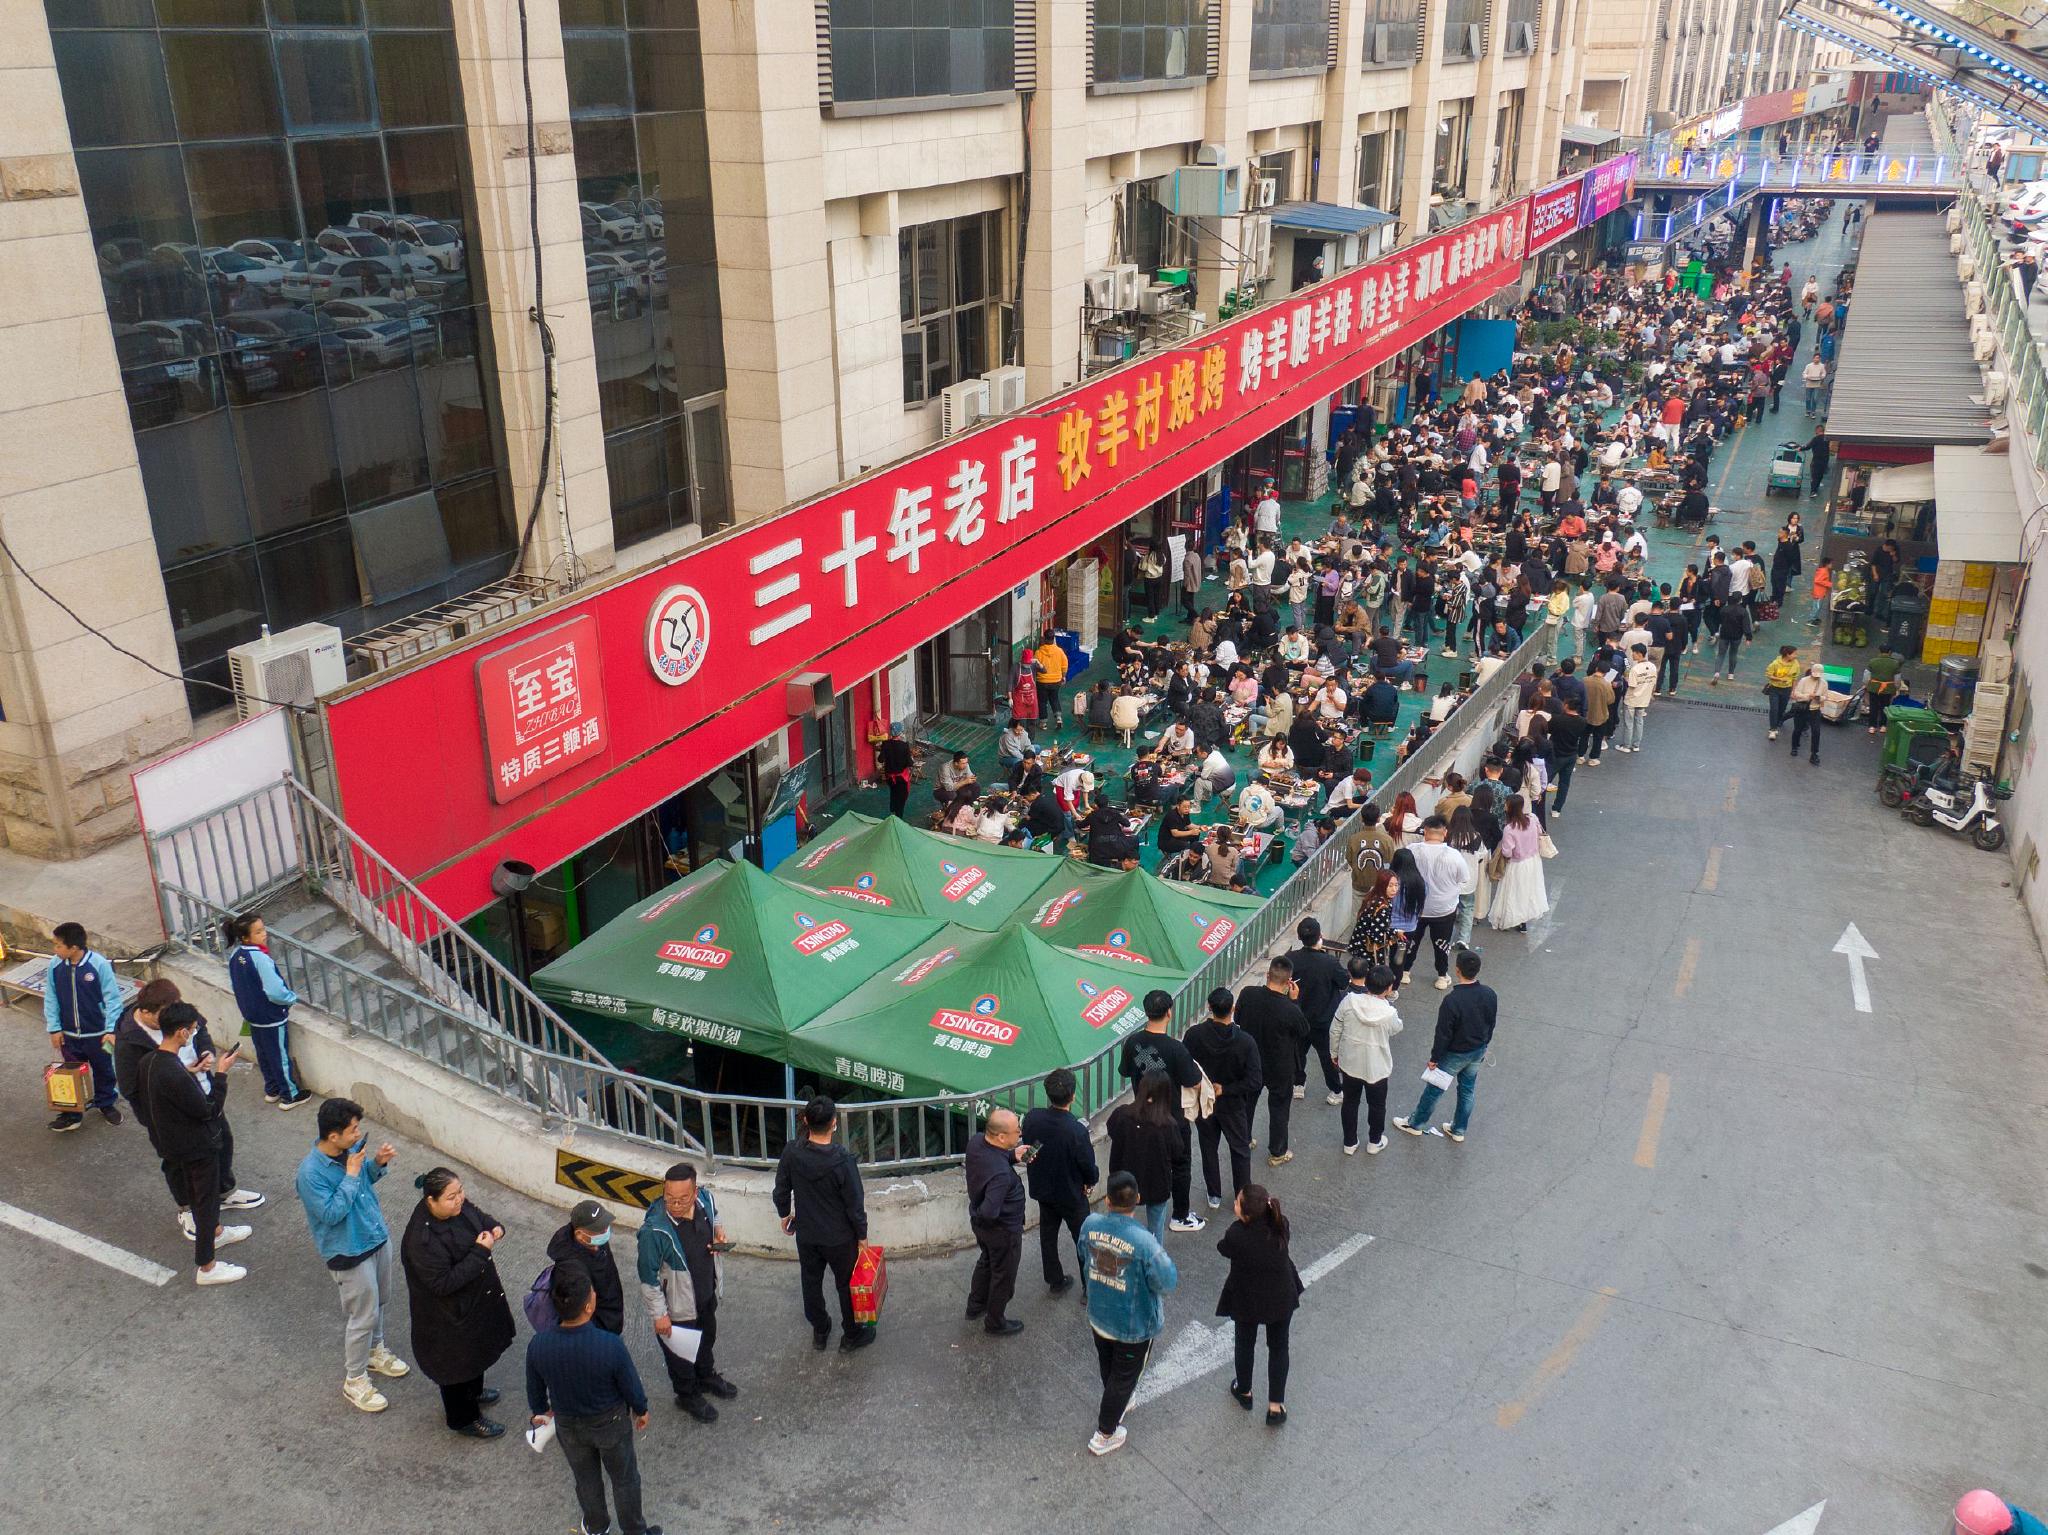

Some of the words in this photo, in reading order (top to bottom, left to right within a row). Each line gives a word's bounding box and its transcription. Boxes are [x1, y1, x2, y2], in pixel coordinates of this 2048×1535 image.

[1359, 262, 1410, 333] 烤全羊
[1238, 287, 1353, 396] 烤羊腿羊排
[1057, 344, 1226, 491] 牧羊村烧烤
[750, 435, 1037, 646] 三十年老店
[514, 656, 576, 719] 至宝
[523, 700, 575, 735] ZHIBAO
[501, 716, 600, 787] 特质三鞭酒
[945, 868, 982, 896] TSINGTAO
[665, 943, 726, 965] TSINGTAO
[798, 923, 846, 950] TSINGTAO
[1086, 989, 1127, 1022] TSINGTAO
[652, 1007, 742, 1046] 畅享欢聚时刻
[940, 1012, 1012, 1040] TSINGTAO
